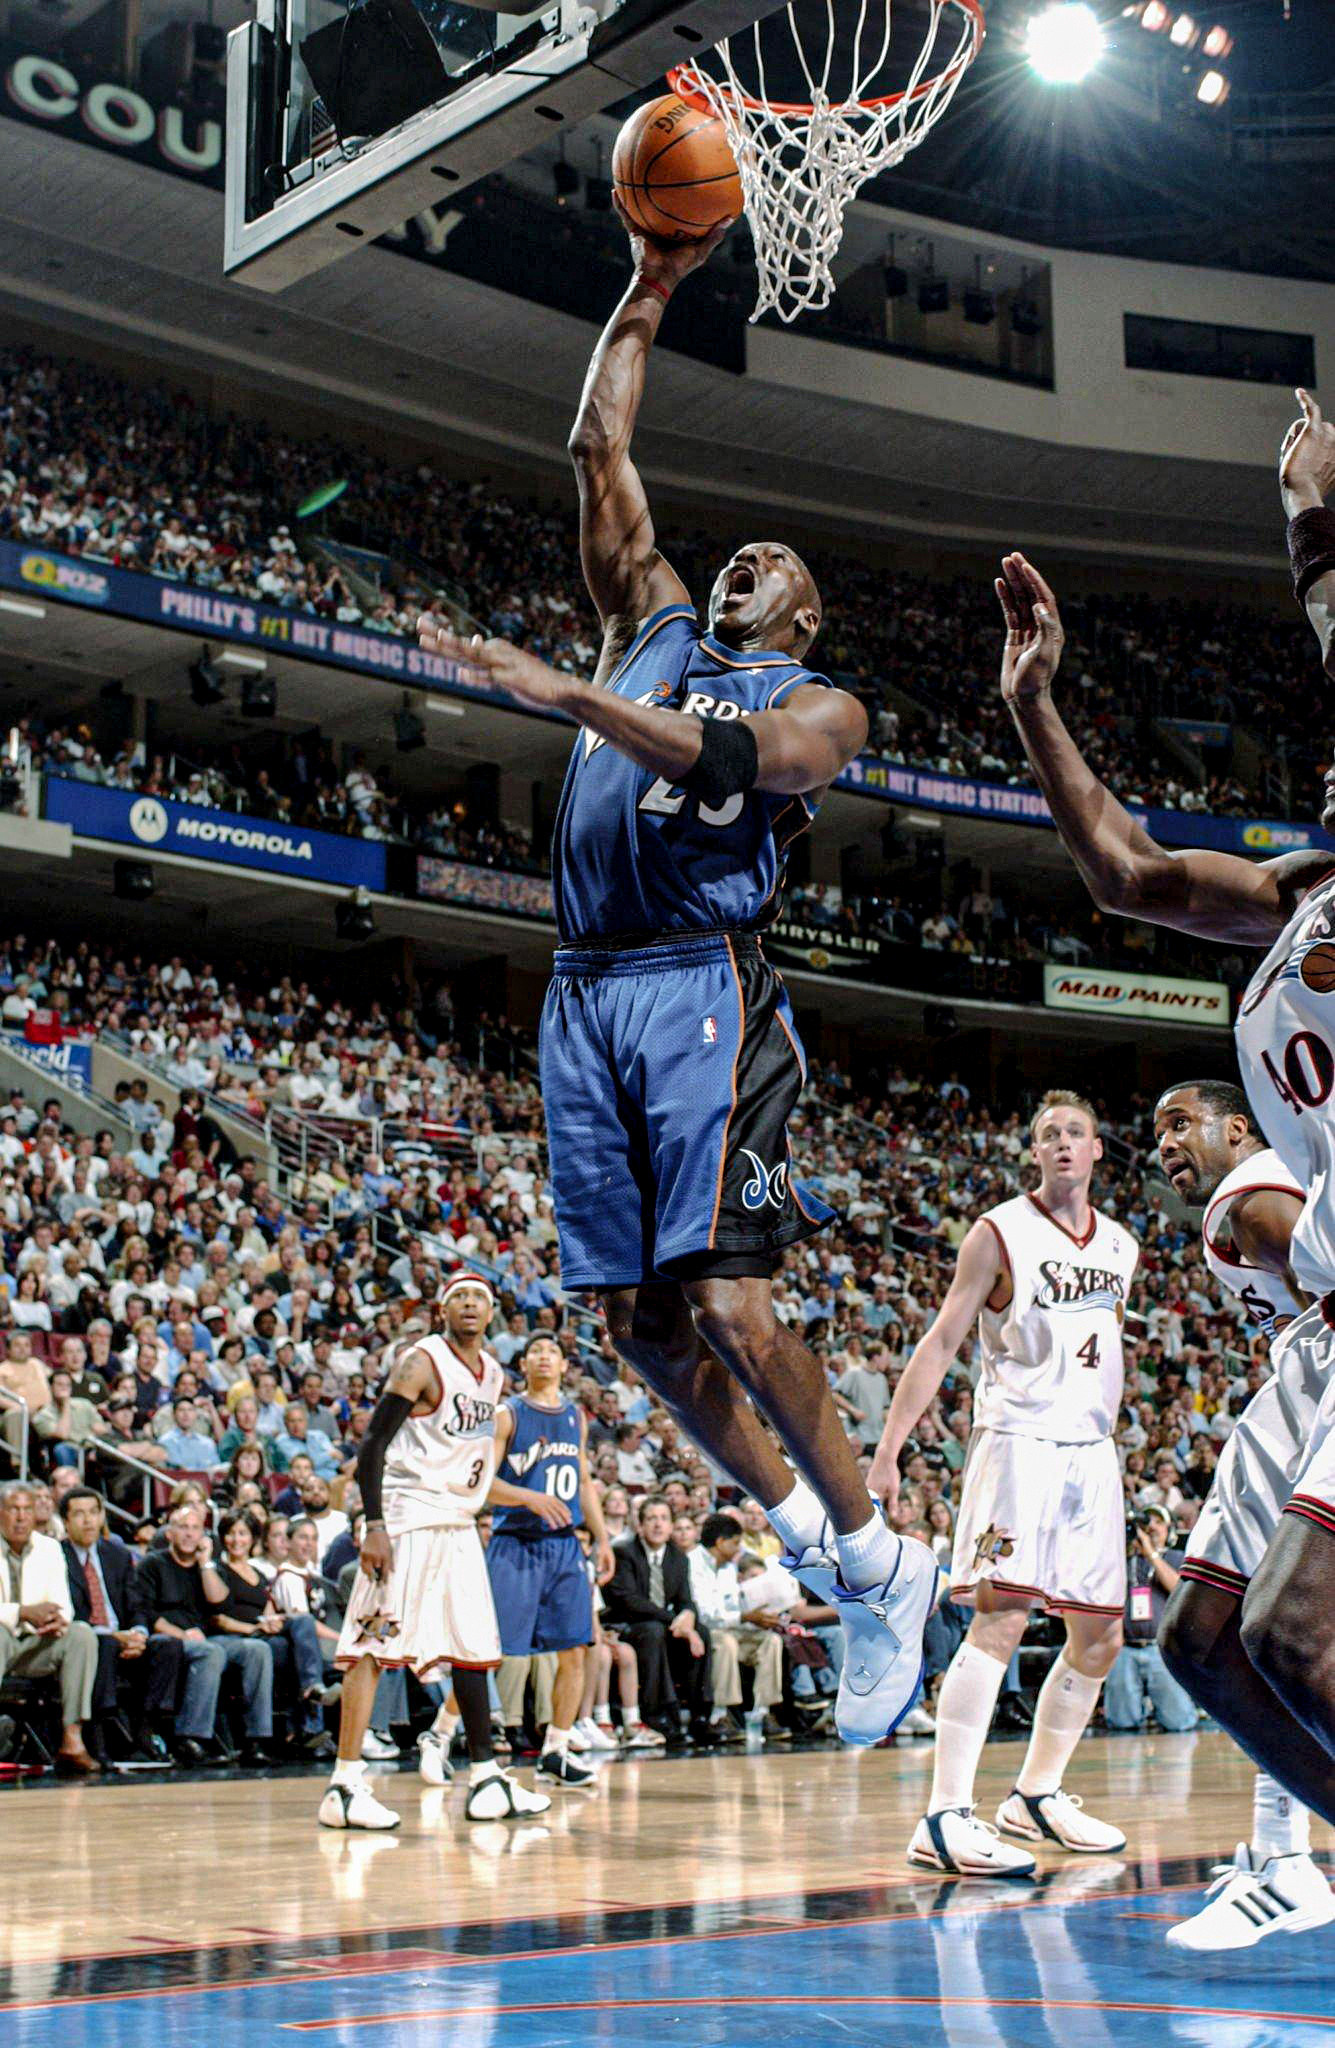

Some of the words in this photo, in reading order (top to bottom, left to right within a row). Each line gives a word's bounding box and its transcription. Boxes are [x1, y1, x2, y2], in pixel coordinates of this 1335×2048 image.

[160, 586, 257, 634] PHILLY'S
[260, 615, 289, 641] #1
[292, 619, 330, 650] HIT
[332, 630, 404, 671] MUSIC
[865, 767, 887, 788] #1
[917, 775, 977, 809] MUSIC
[176, 816, 313, 860] MOTOROLA
[770, 921, 880, 954] HRYSLER
[1058, 980, 1121, 1000] MAB
[1128, 988, 1221, 1010] PAINTS
[1260, 1031, 1335, 1116] 40
[1076, 1333, 1100, 1369] 4
[467, 1459, 484, 1489] 3
[545, 1464, 578, 1500] 10
